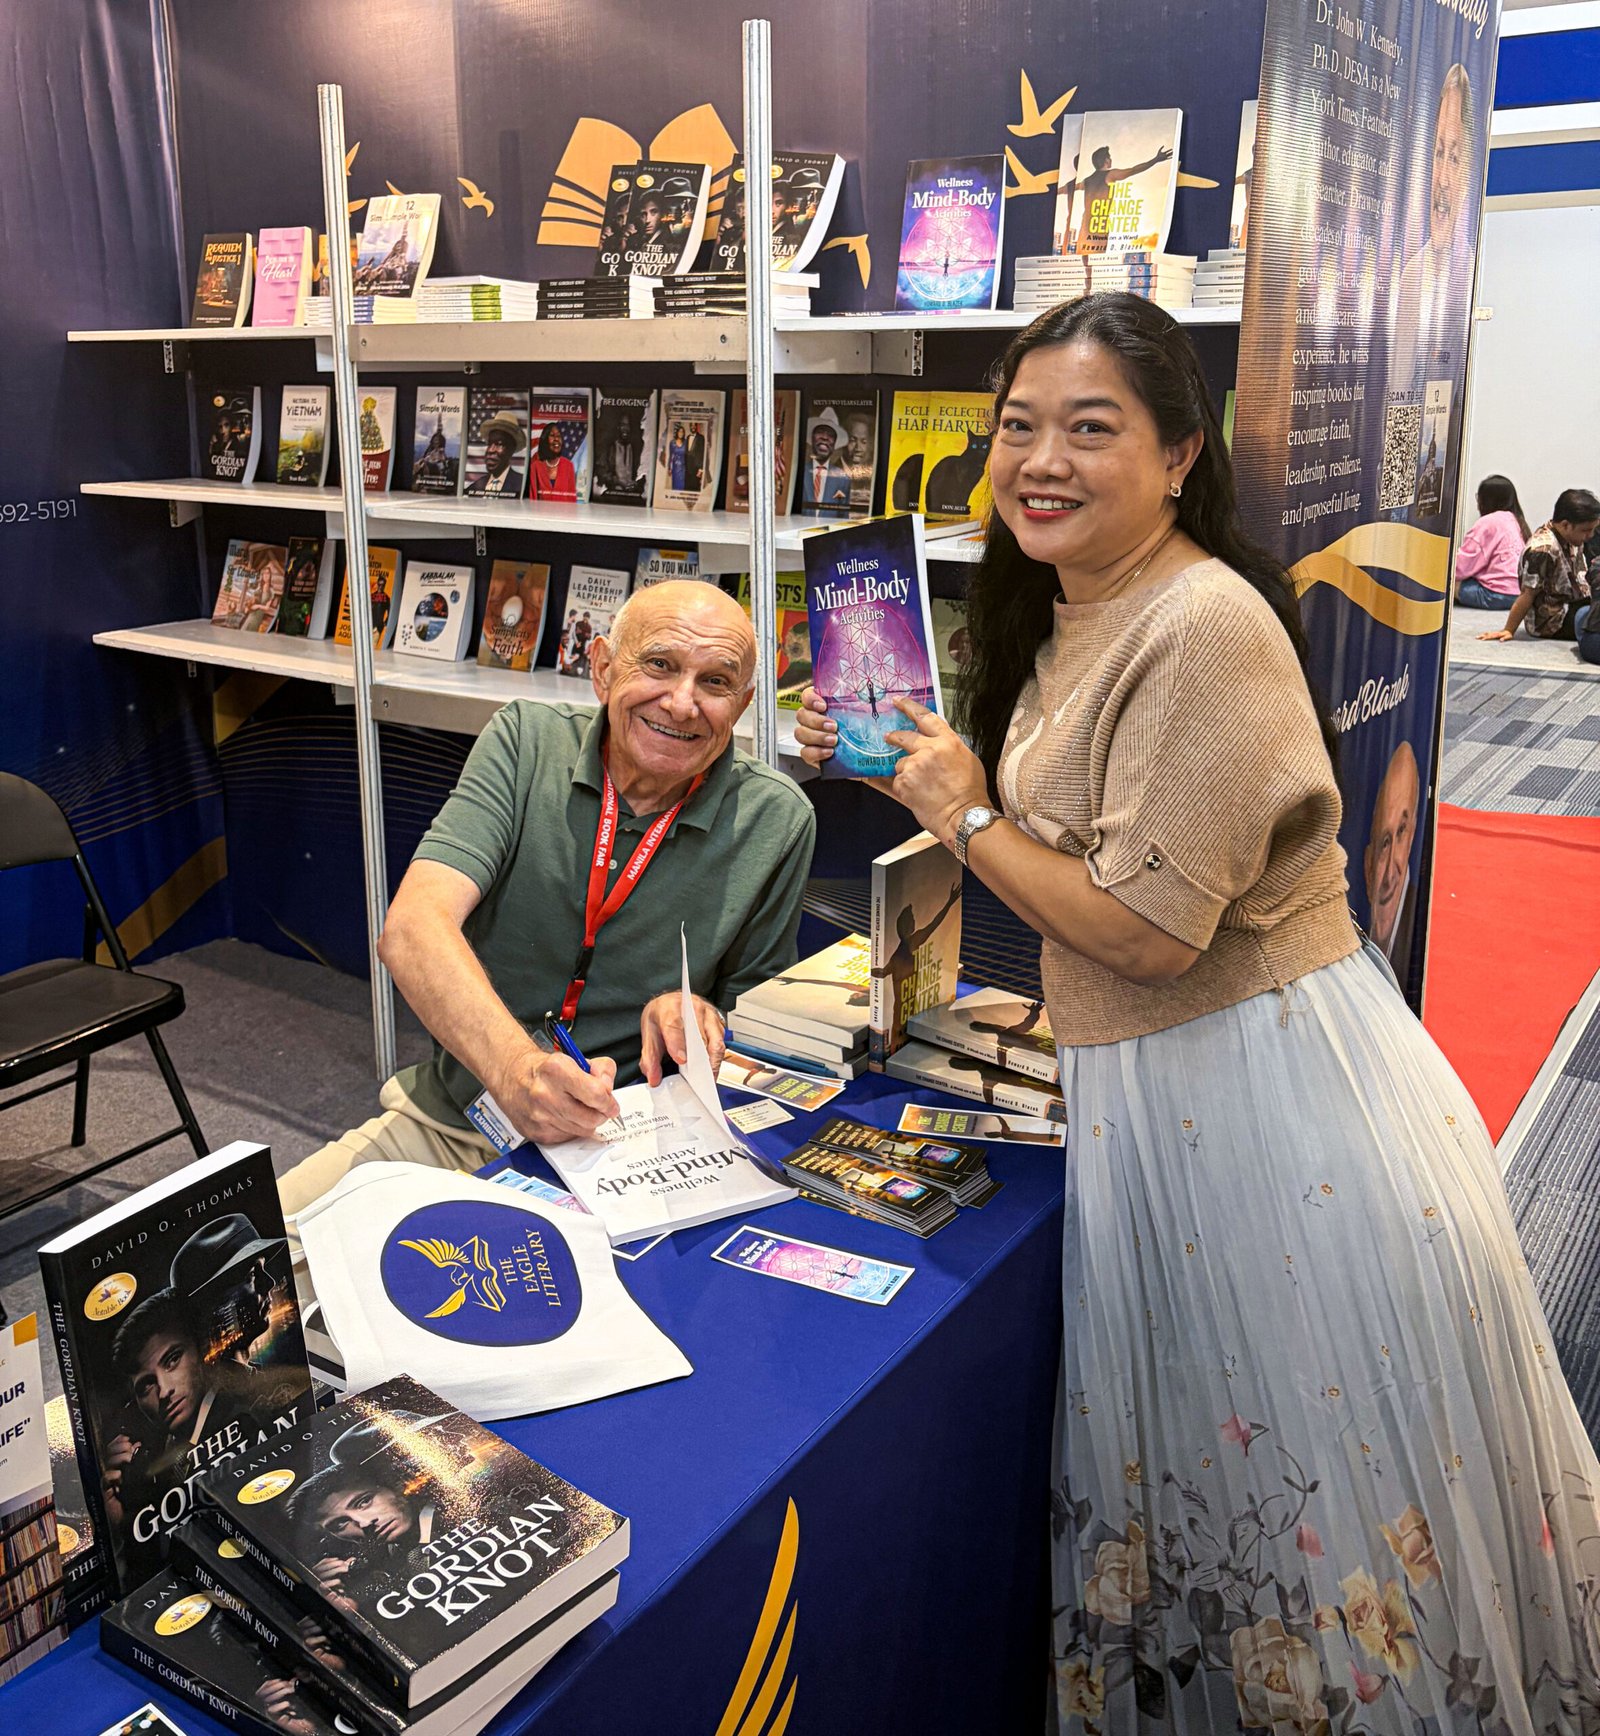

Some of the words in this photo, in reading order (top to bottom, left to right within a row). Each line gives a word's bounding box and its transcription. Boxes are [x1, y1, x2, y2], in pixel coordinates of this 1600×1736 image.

[1316, 0, 1335, 27] Dr.
[1335, 7, 1354, 39] John
[1356, 19, 1368, 45] W.
[1370, 19, 1404, 65] Kennedy,
[1312, 44, 1343, 81] Ph.D.,
[1344, 57, 1370, 90] DESA
[1371, 68, 1379, 87] is
[1379, 76, 1383, 88] a
[1384, 76, 1402, 100] New
[1310, 88, 1335, 116] York
[1337, 97, 1359, 127] Times
[1361, 105, 1393, 139] Featured
[1341, 145, 1378, 177] educator,
[1378, 156, 1393, 178] and
[937, 177, 974, 189] Wellness
[1108, 182, 1133, 199] THE
[405, 201, 415, 210] 12
[912, 187, 996, 210] Mind-Body
[1091, 199, 1144, 217] CHANGE
[1350, 186, 1381, 219] Drawing
[1382, 200, 1393, 216] on
[934, 209, 972, 219] Activities
[1089, 216, 1139, 234] CENTER
[206, 242, 243, 257] REQUIEM
[624, 250, 679, 264] GORDIAN
[646, 244, 664, 253] THE
[1120, 243, 1144, 251] Blazek
[631, 263, 667, 276] KNOT
[1296, 303, 1316, 325] and
[1339, 343, 1350, 365] he
[436, 392, 445, 403] 12
[602, 398, 650, 408] BELONGING
[1290, 383, 1327, 409] inspiring
[1327, 382, 1353, 402] books
[1354, 383, 1365, 401] that
[1388, 391, 1406, 402] SCAN
[1408, 390, 1415, 401] TO
[286, 406, 322, 416] VIETNAM
[419, 404, 440, 413] Simple
[440, 405, 460, 413] Words
[538, 404, 583, 414] AMERICA
[932, 418, 991, 434] HARVES
[1287, 421, 1329, 448] encourage
[211, 455, 245, 467] GORDIAN
[215, 466, 239, 477] KNOT
[1285, 460, 1327, 487] leadership,
[1329, 456, 1362, 478] resilience,
[1282, 505, 1302, 527] and
[1303, 494, 1343, 528] purposeful
[1344, 490, 1362, 514] living.
[421, 572, 456, 581] KABBALAH,
[650, 559, 660, 572] SO
[661, 560, 677, 574] YOU
[677, 561, 699, 576] WANT
[837, 557, 879, 577] Wellness
[572, 582, 624, 596] LEADERSHIP
[587, 577, 612, 586] DAILY
[814, 569, 911, 613] Mind-Body
[575, 591, 619, 604] ALPHABET
[840, 607, 886, 626] Activities
[490, 625, 532, 641] Simplicity
[493, 638, 525, 656] Faith
[1361, 663, 1410, 724] Blazek
[858, 756, 880, 766] HOWARD
[599, 818, 612, 846] BOOK
[595, 846, 607, 867] FAIR
[627, 847, 651, 880] MANILA
[911, 941, 934, 973] THE
[900, 957, 943, 1004] CHANGE
[900, 981, 942, 1026] CENTER
[1008, 1060, 1025, 1070] Howard
[1032, 1066, 1049, 1078] Blazek
[995, 1096, 1013, 1106] Howard
[1021, 1102, 1039, 1112] Blazek
[473, 1111, 505, 1149] EXHIBITOR
[638, 1115, 670, 1128] HOWARD
[627, 1147, 697, 1170] Activities
[596, 1146, 748, 1196] Mind-Body
[650, 1174, 720, 1197] Wellness
[91, 1231, 148, 1270] DAVID
[158, 1220, 176, 1232] O.
[184, 1176, 254, 1219] THOMAS
[499, 1256, 518, 1286] THE
[512, 1244, 541, 1293] EAGLE
[525, 1228, 562, 1307] LITERARY
[53, 1301, 66, 1333] THE
[59, 1337, 79, 1401] GORDIAN
[73, 1406, 87, 1446] KNOT
[186, 1420, 242, 1470] THE
[233, 1444, 293, 1478] DAVID
[302, 1431, 322, 1441] O.
[421, 1517, 487, 1559] THE
[216, 1512, 233, 1536] THE
[234, 1531, 271, 1571] GORDIAN
[273, 1564, 296, 1592] KNOT
[377, 1494, 566, 1620] GORDIAN
[69, 1555, 99, 1582] THE
[425, 1528, 561, 1626] KNOT
[195, 1565, 213, 1590] THE
[214, 1584, 254, 1626] GORDIAN
[254, 1618, 280, 1649] KNOT
[132, 1647, 154, 1670] THE
[158, 1663, 205, 1700] GORDIAN
[208, 1692, 239, 1721] KNOT
